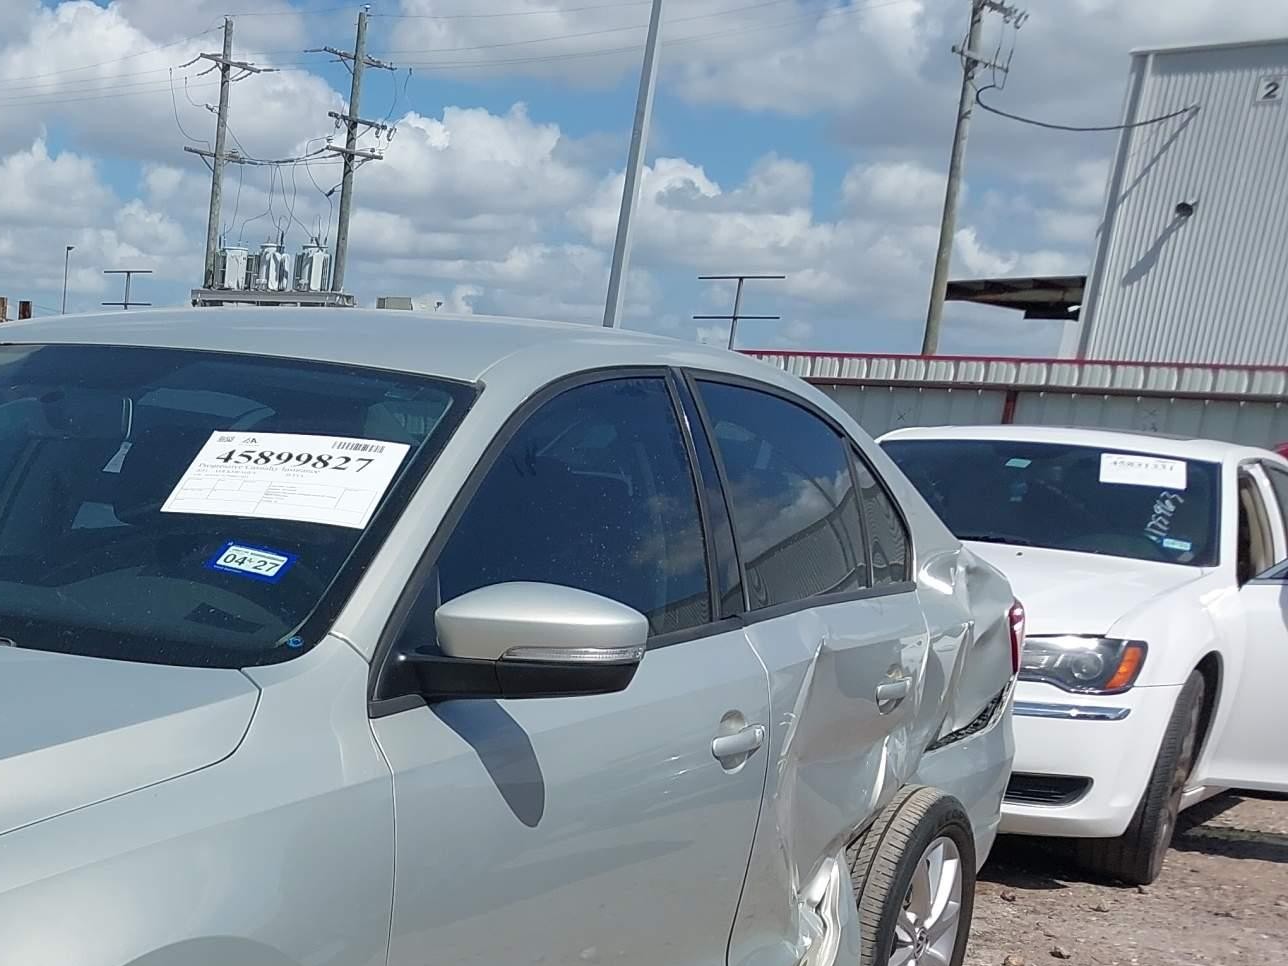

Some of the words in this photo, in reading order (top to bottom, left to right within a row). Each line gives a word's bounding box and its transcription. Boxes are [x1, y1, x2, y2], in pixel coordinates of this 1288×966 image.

[1262, 82, 1280, 100] 2
[215, 449, 375, 473] 45899827
[223, 553, 248, 566] 04
[252, 560, 280, 572] 27
